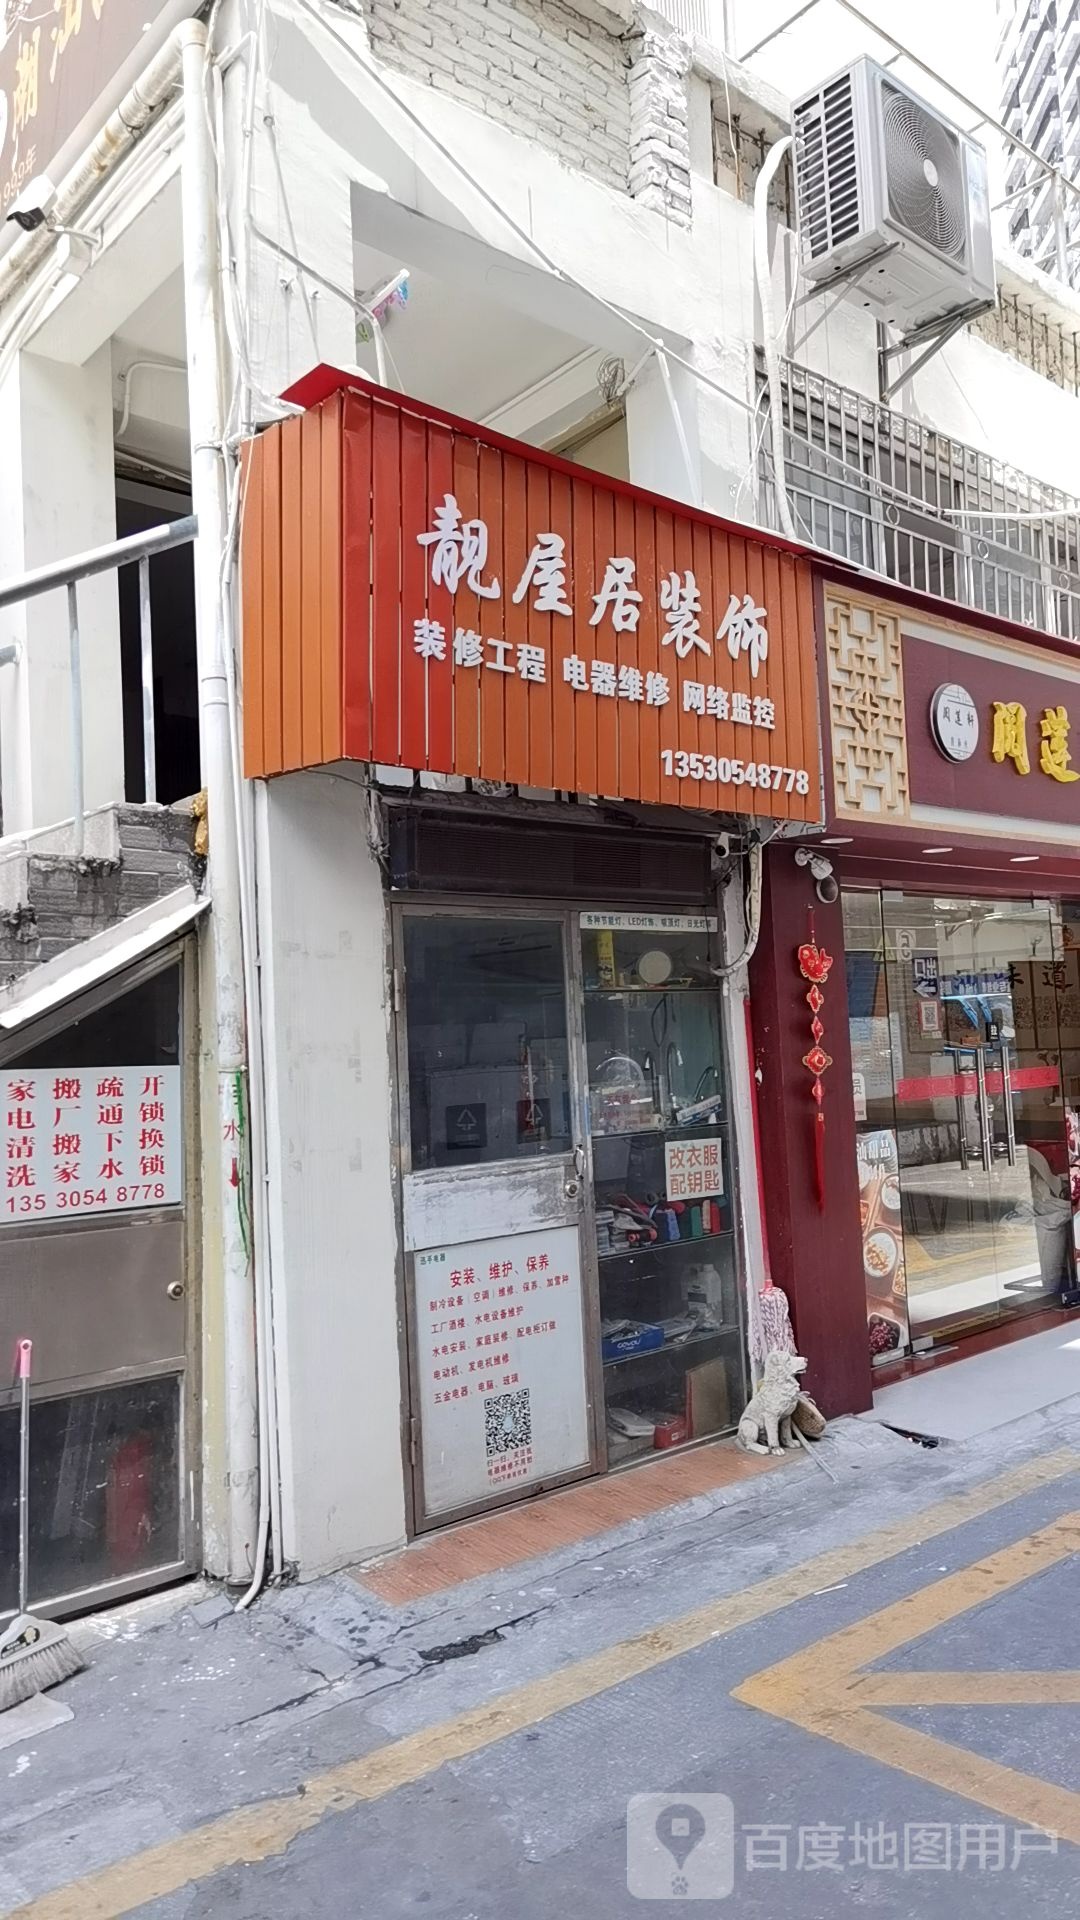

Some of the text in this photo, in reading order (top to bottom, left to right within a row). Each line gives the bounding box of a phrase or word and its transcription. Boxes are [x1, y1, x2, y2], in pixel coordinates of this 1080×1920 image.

[416, 494, 770, 679] 靓屋居装饰
[413, 618, 776, 731] 装修工程 电器维修 网络监控
[660, 749, 810, 795] 13530548778
[6, 1078, 37, 1188] 家电清洗
[52, 1077, 82, 1184] 搬厂搬家
[96, 1075, 125, 1180] 疏通下水
[138, 1073, 166, 1177] 开锁换锁
[669, 1144, 719, 1169] 改衣服
[6, 1183, 165, 1213] 135 3054 8778
[669, 1169, 720, 1196] 配钥匙
